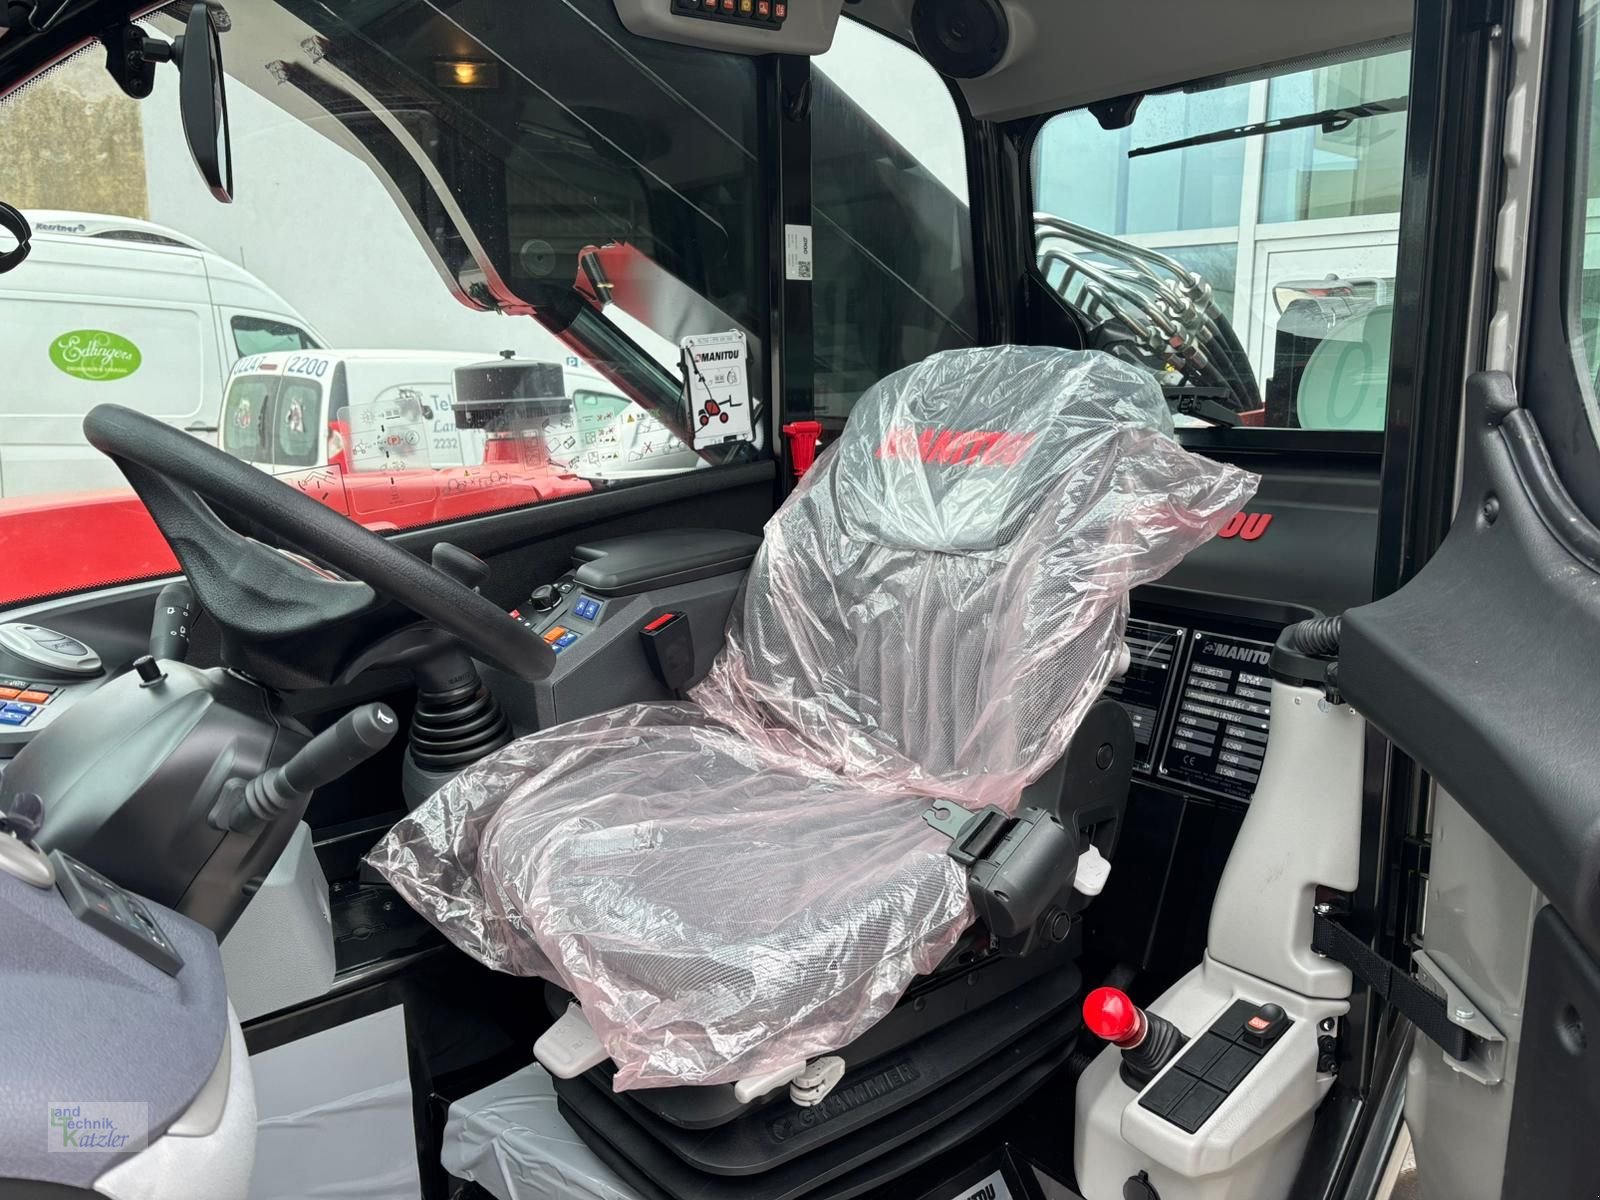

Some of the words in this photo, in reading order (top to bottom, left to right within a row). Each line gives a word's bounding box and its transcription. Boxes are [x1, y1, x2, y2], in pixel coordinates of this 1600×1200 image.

[288, 356, 328, 377] 2200
[701, 350, 739, 362] MANITOU
[1213, 643, 1271, 665] MANITO
[799, 1062, 916, 1128] GRAMMER
